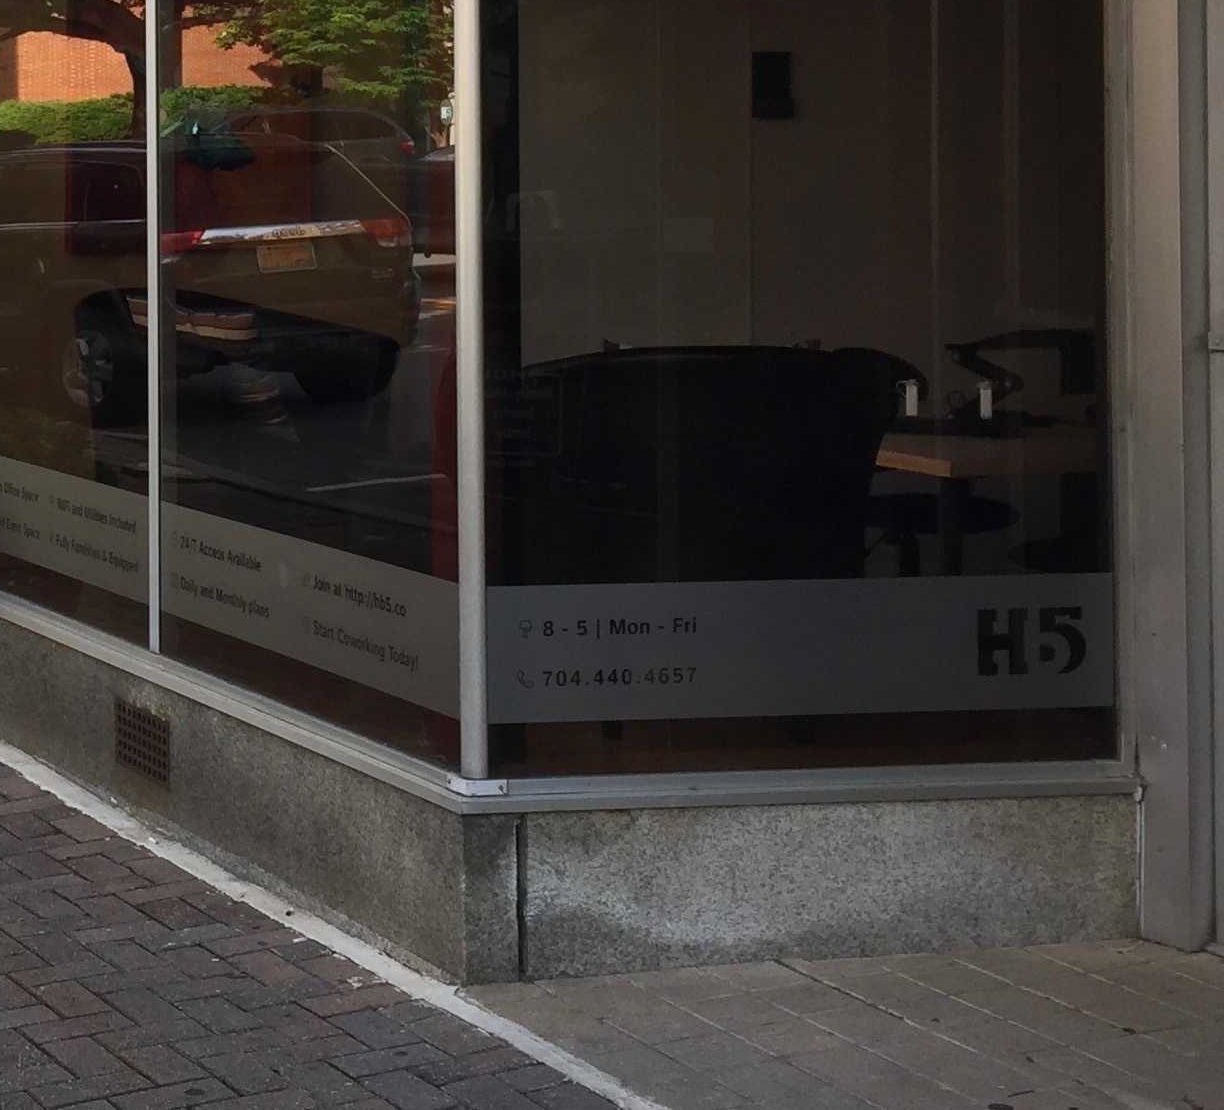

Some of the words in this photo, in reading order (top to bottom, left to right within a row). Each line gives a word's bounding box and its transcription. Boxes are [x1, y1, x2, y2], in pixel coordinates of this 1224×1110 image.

[198, 541, 226, 563] Access
[226, 549, 262, 572] Available
[180, 575, 199, 597] Daily
[199, 584, 214, 600] and
[215, 587, 248, 614] Monthly
[313, 575, 332, 594] Join
[332, 582, 343, 598] at
[542, 620, 555, 637] 8
[576, 619, 588, 636] 5
[609, 618, 651, 635] Mon
[672, 616, 697, 633] Fri
[313, 619, 336, 641] Start
[337, 627, 386, 662] Coworking
[387, 644, 420, 673] Today!
[542, 666, 697, 688] 704.440.4657
